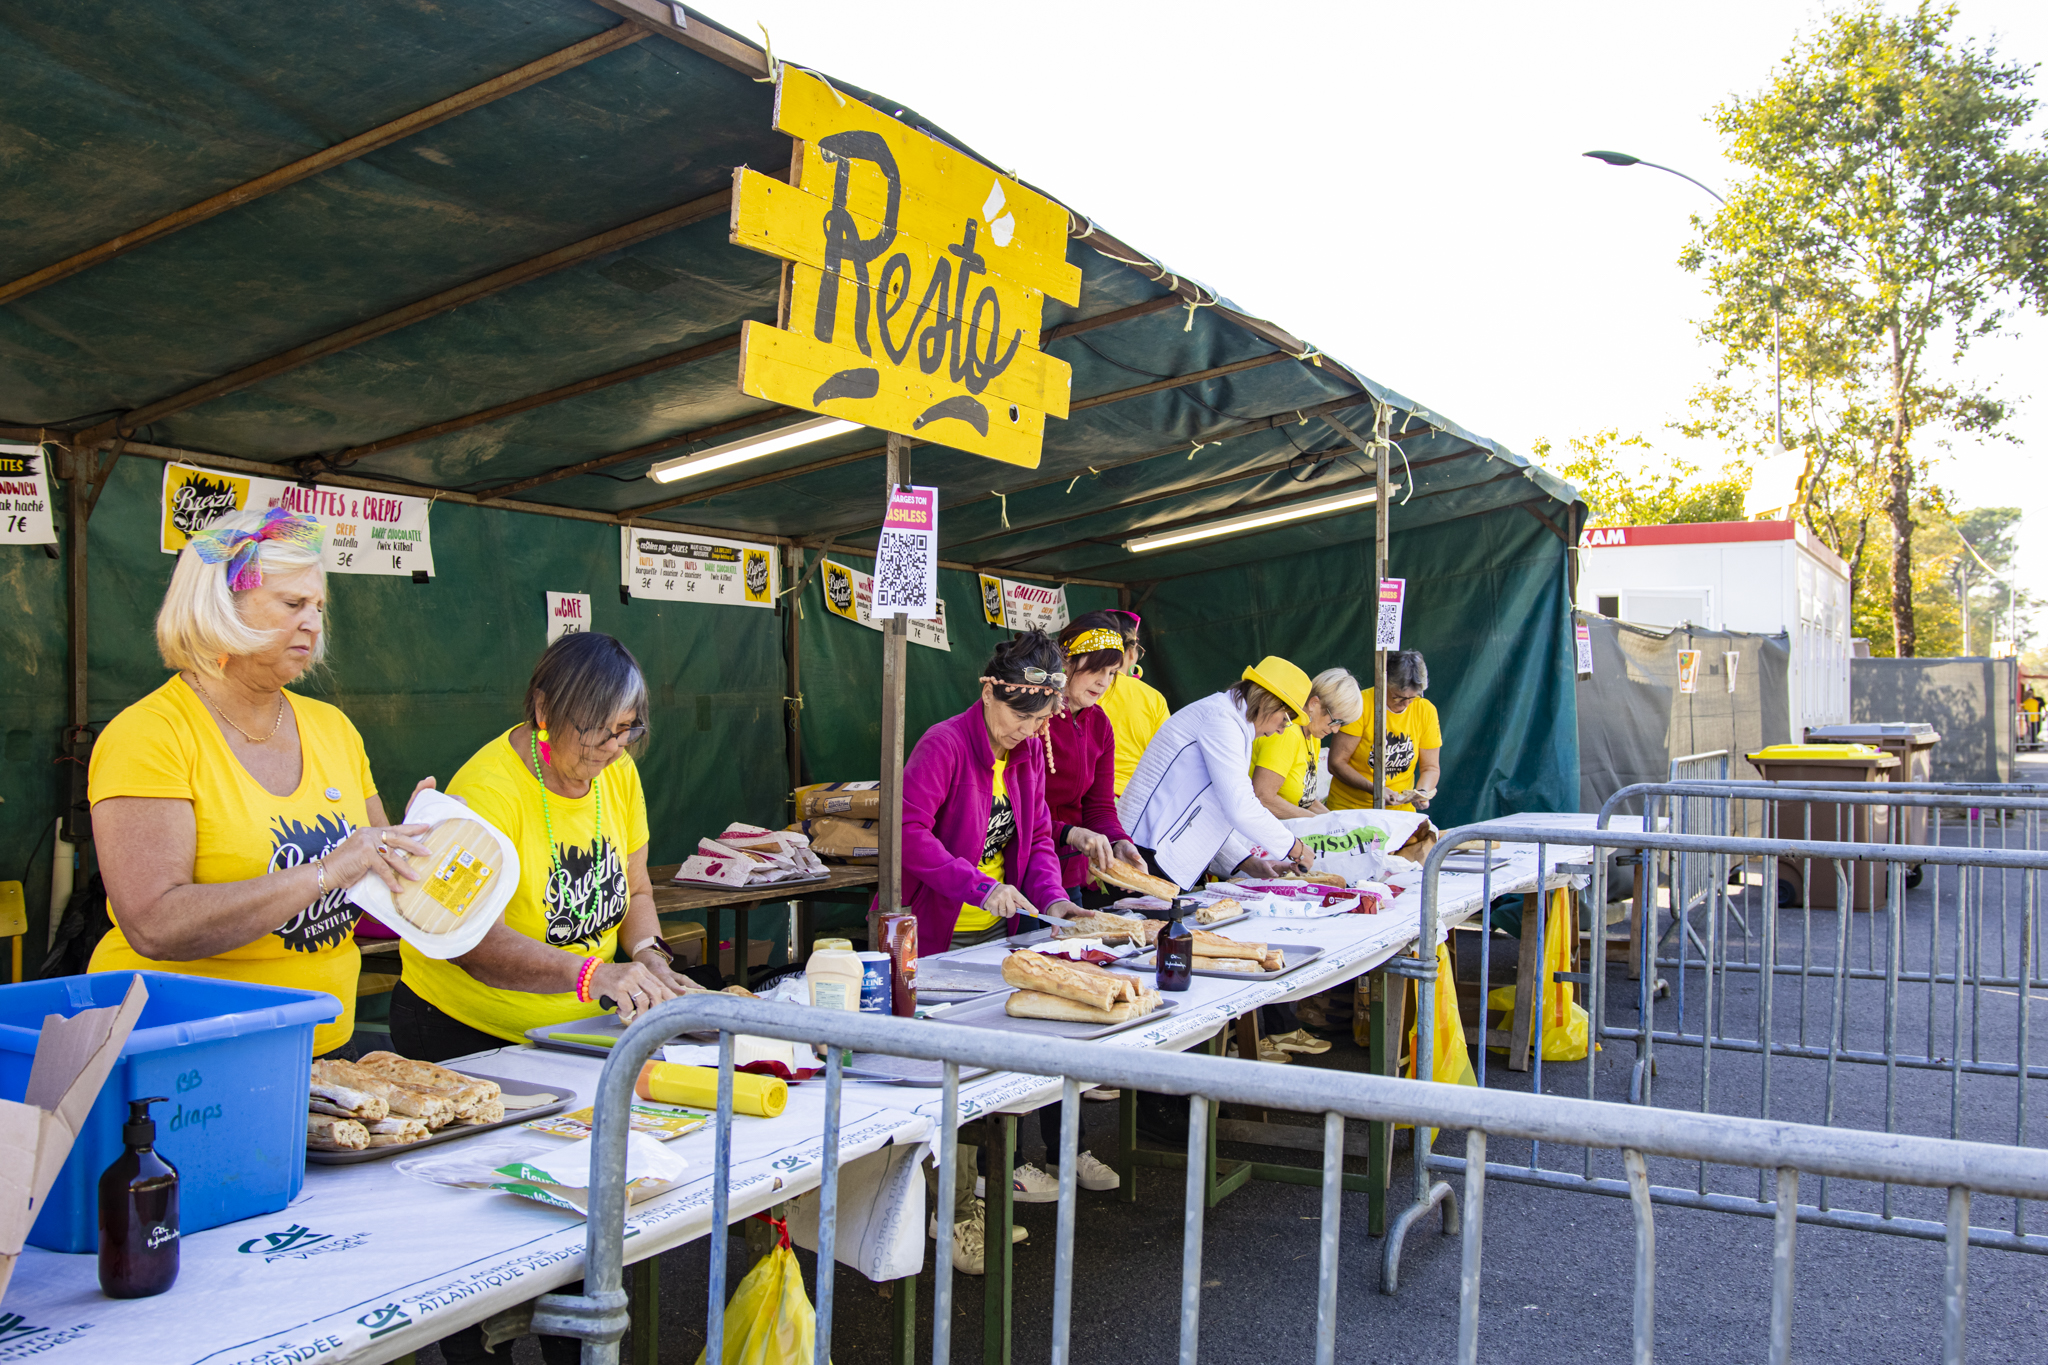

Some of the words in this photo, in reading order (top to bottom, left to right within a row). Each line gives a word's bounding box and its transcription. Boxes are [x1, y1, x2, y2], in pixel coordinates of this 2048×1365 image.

[814, 130, 1022, 395] Resto
[0, 481, 38, 496] NDWICH
[15, 500, 44, 512] haché
[172, 486, 237, 512] Breizh
[281, 486, 345, 517] GALETTES
[351, 500, 359, 518] &
[916, 496, 927, 505] TON
[7, 515, 27, 533] 7€
[184, 509, 218, 532] Foli
[886, 508, 927, 523] ASHLESS
[371, 526, 386, 539] BARRE
[332, 537, 358, 548] nutella
[337, 552, 353, 567] 3€
[392, 555, 402, 569] 1€
[639, 556, 653, 566] FRITES
[641, 577, 651, 588] 3€
[665, 579, 674, 590] 4€
[687, 581, 695, 592] 5€
[1014, 585, 1053, 604] GALETTES
[1384, 736, 1413, 756] reizh
[865, 798, 878, 806] TYP
[1313, 833, 1368, 860] Festi
[545, 842, 620, 920] Breizh
[304, 909, 353, 939] FESTIVAL
[176, 1069, 202, 1093] BB
[984, 1081, 1032, 1107] ATLANTIQUE
[170, 1103, 222, 1132] draps
[470, 1249, 552, 1281] AGRICOLE
[418, 1267, 524, 1315] ATLANTIQUE
[524, 1243, 587, 1272] VENDÉE
